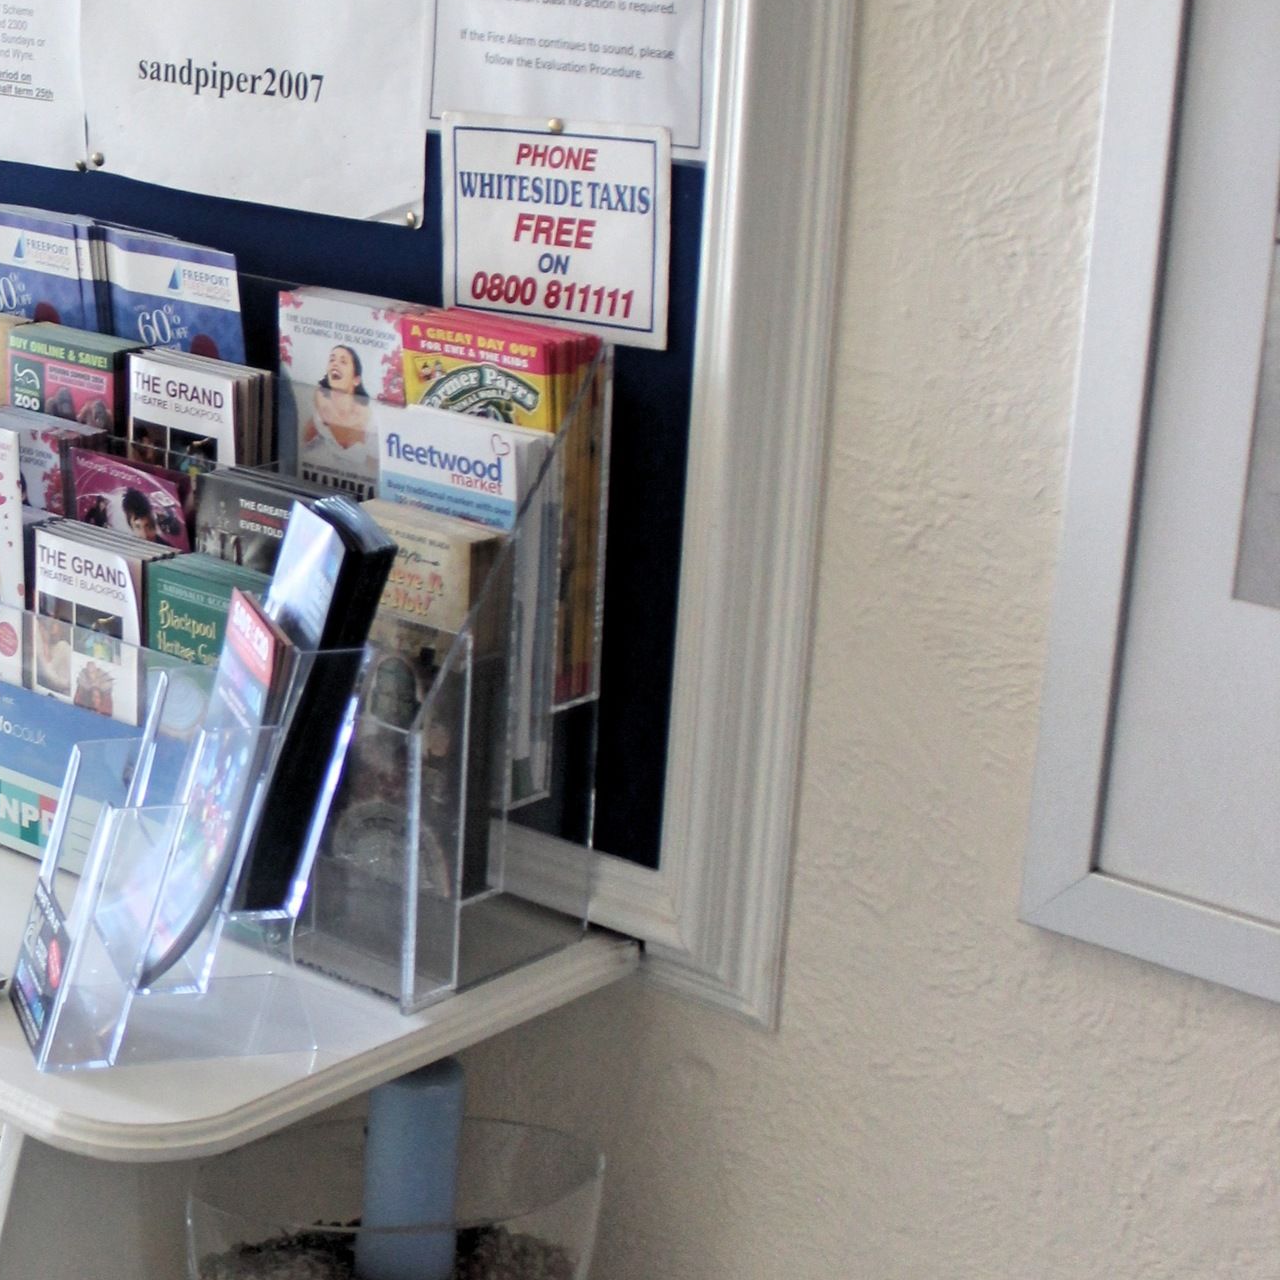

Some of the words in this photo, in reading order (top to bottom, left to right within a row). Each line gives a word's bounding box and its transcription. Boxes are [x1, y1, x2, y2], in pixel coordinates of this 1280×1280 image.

[618, 0, 626, 10] is
[629, 0, 677, 17] required.
[460, 29, 468, 40] If
[470, 30, 484, 42] the
[487, 31, 505, 43] Fire
[507, 33, 536, 46] Alarm
[539, 35, 586, 51] continues
[589, 39, 600, 52] to
[603, 40, 636, 58] sound,
[639, 43, 674, 62] please
[138, 58, 324, 103] sandpiper2007
[485, 52, 513, 66] follow
[516, 55, 532, 68] the
[535, 57, 587, 73] Evaluation
[589, 63, 644, 78] Procedure.
[516, 143, 598, 171] PHONE
[460, 171, 584, 207] WHITESIDE
[587, 182, 651, 214] TAXIS
[513, 213, 597, 249] FREE
[26, 238, 69, 257] FREEPORT
[182, 269, 229, 288] FREEPORT
[538, 253, 570, 275] ON
[472, 271, 537, 305] 0800
[544, 280, 634, 318] 811111
[10, 336, 28, 349] BUY
[30, 341, 65, 359] ONLINE
[68, 350, 75, 361] &
[78, 352, 107, 368] SAVE!
[411, 325, 421, 336] A
[426, 327, 473, 345] GREAT
[477, 336, 505, 352] DAY
[509, 343, 538, 358] OUT
[420, 340, 441, 352] FOR
[444, 344, 465, 356] EWE
[468, 348, 476, 358] &
[479, 350, 500, 362] THE
[502, 354, 529, 368] KIDS
[15, 394, 40, 410] ZOO
[135, 371, 161, 394] THE
[166, 380, 224, 408] GRAND
[485, 368, 536, 406] Parrs
[134, 393, 168, 409] THEATRE
[174, 403, 224, 423] BLACKPOOL
[386, 433, 503, 482] fleetwood
[451, 473, 503, 495] market
[239, 498, 255, 511] THE
[257, 502, 291, 520] GREATE
[239, 521, 261, 533] EVER
[262, 526, 284, 538] TOLD
[39, 544, 66, 569] THE
[71, 556, 127, 588] GRAND
[39, 567, 73, 585] THEATRE
[80, 580, 128, 602] BLACKPOOL
[159, 600, 216, 640] Blackpool
[156, 631, 196, 662] Heritage
